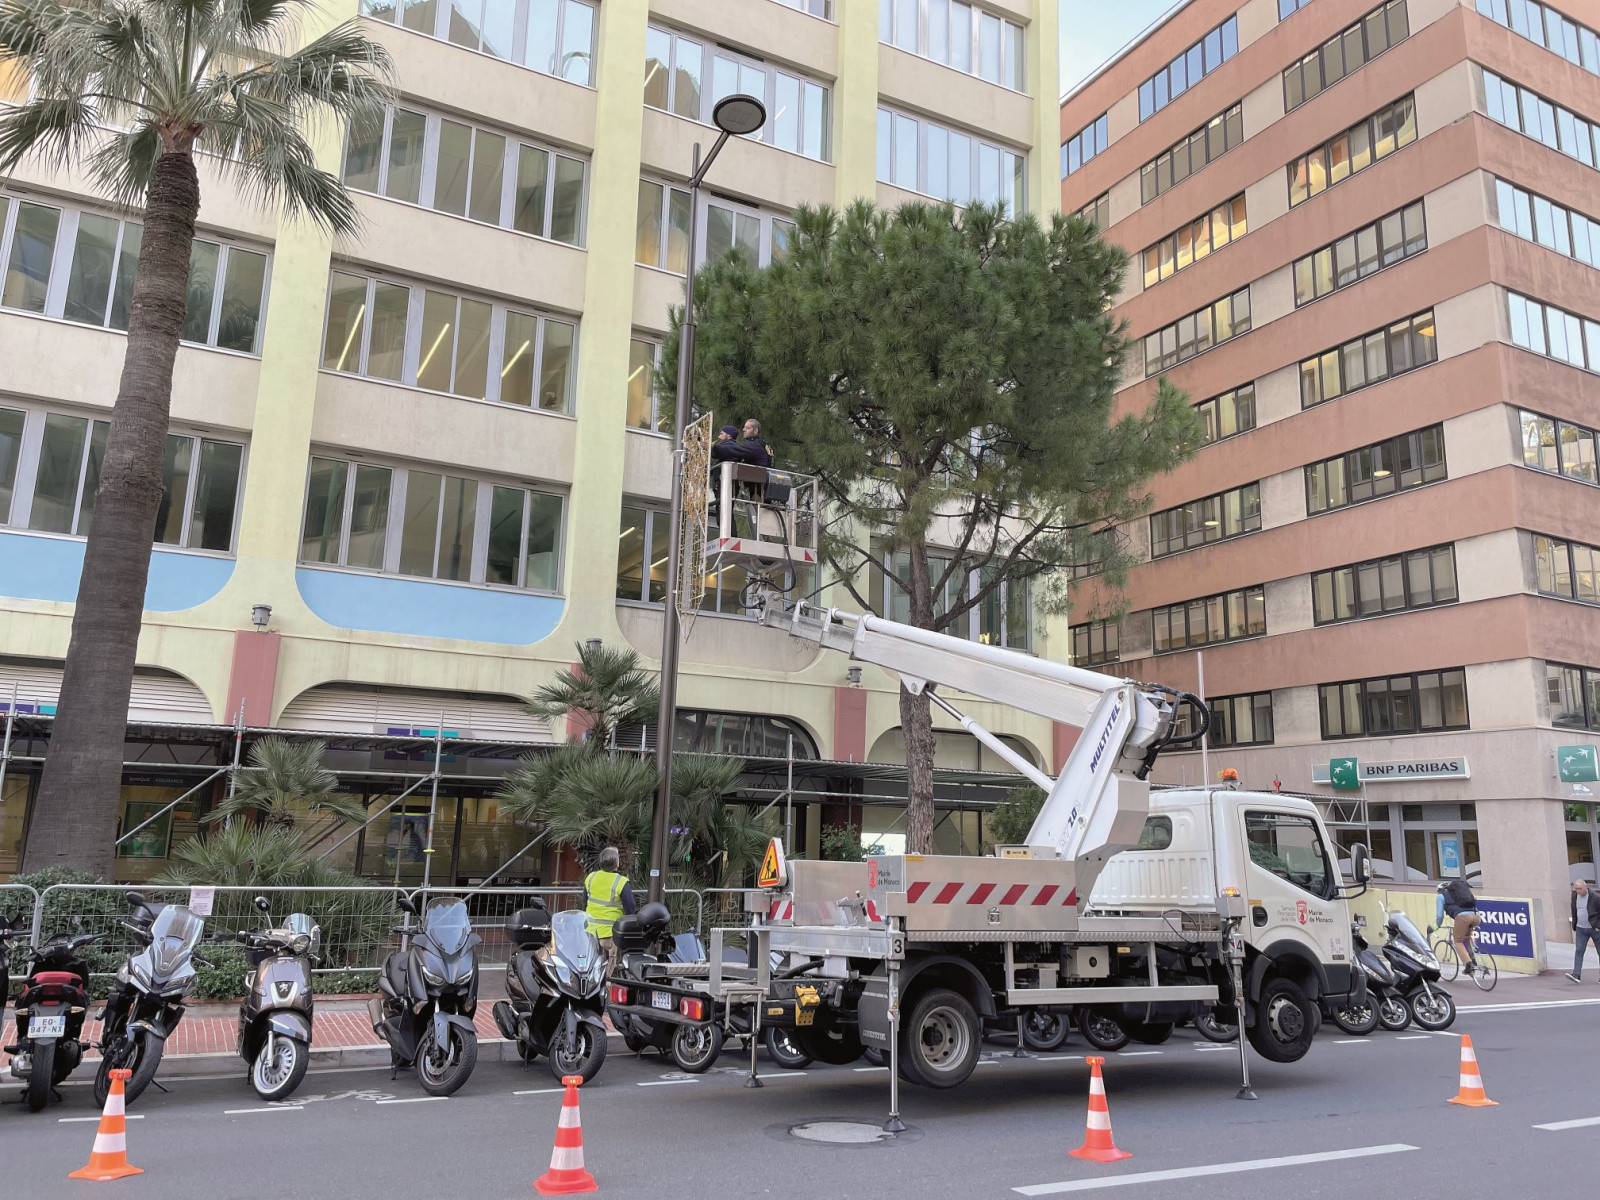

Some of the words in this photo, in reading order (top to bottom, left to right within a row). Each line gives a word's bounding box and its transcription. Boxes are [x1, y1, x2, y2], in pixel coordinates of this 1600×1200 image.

[1090, 703, 1120, 774] MULTITEL
[1367, 765, 1394, 775] BNP
[1398, 762, 1459, 773] PARIBAS
[1476, 910, 1528, 926] RKING
[894, 938, 902, 954] 3
[1236, 939, 1243, 952] 4
[1471, 930, 1518, 946] PRIVE
